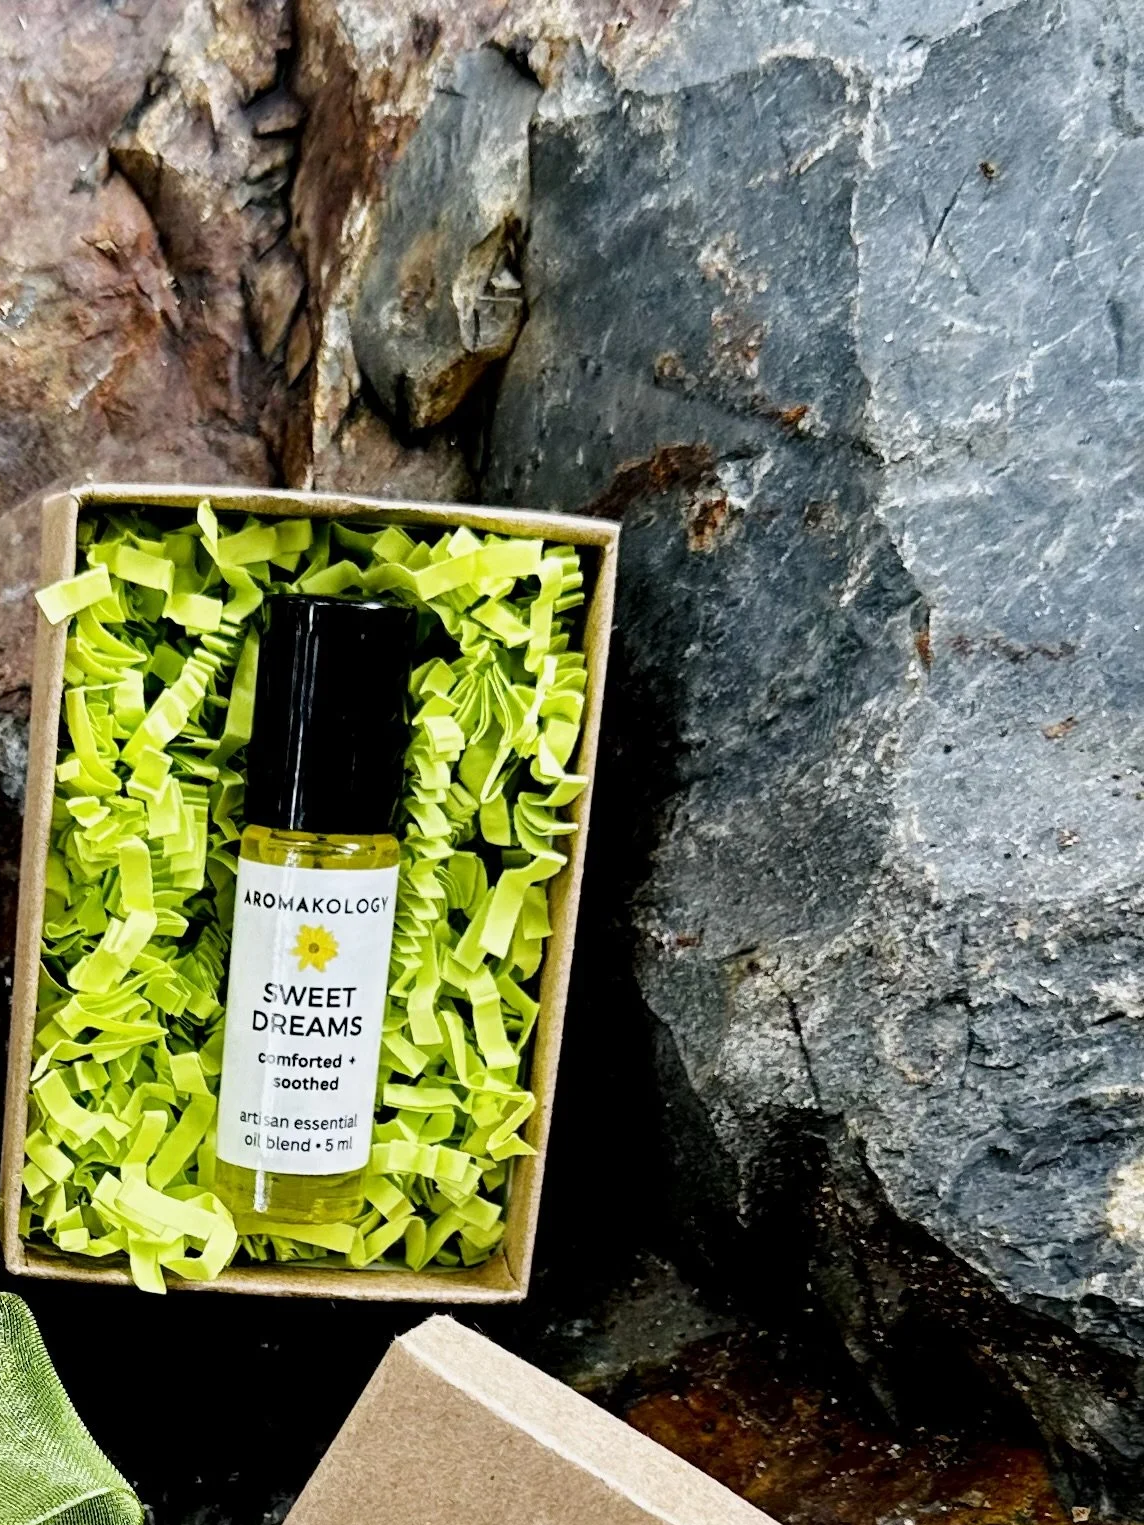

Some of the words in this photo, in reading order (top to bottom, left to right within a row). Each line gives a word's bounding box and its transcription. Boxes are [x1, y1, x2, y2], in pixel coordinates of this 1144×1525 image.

[243, 888, 389, 915] AROMAKOLOGY
[262, 982, 357, 1009] SWEET
[252, 1010, 363, 1038] DREAMS
[258, 1052, 342, 1069] comforted
[272, 1077, 339, 1092] soothed
[240, 1110, 289, 1130] artisan
[293, 1113, 358, 1131] essential
[244, 1133, 261, 1148] oil
[266, 1134, 311, 1153] blend
[325, 1138, 335, 1153] 5
[337, 1135, 354, 1152] ml
